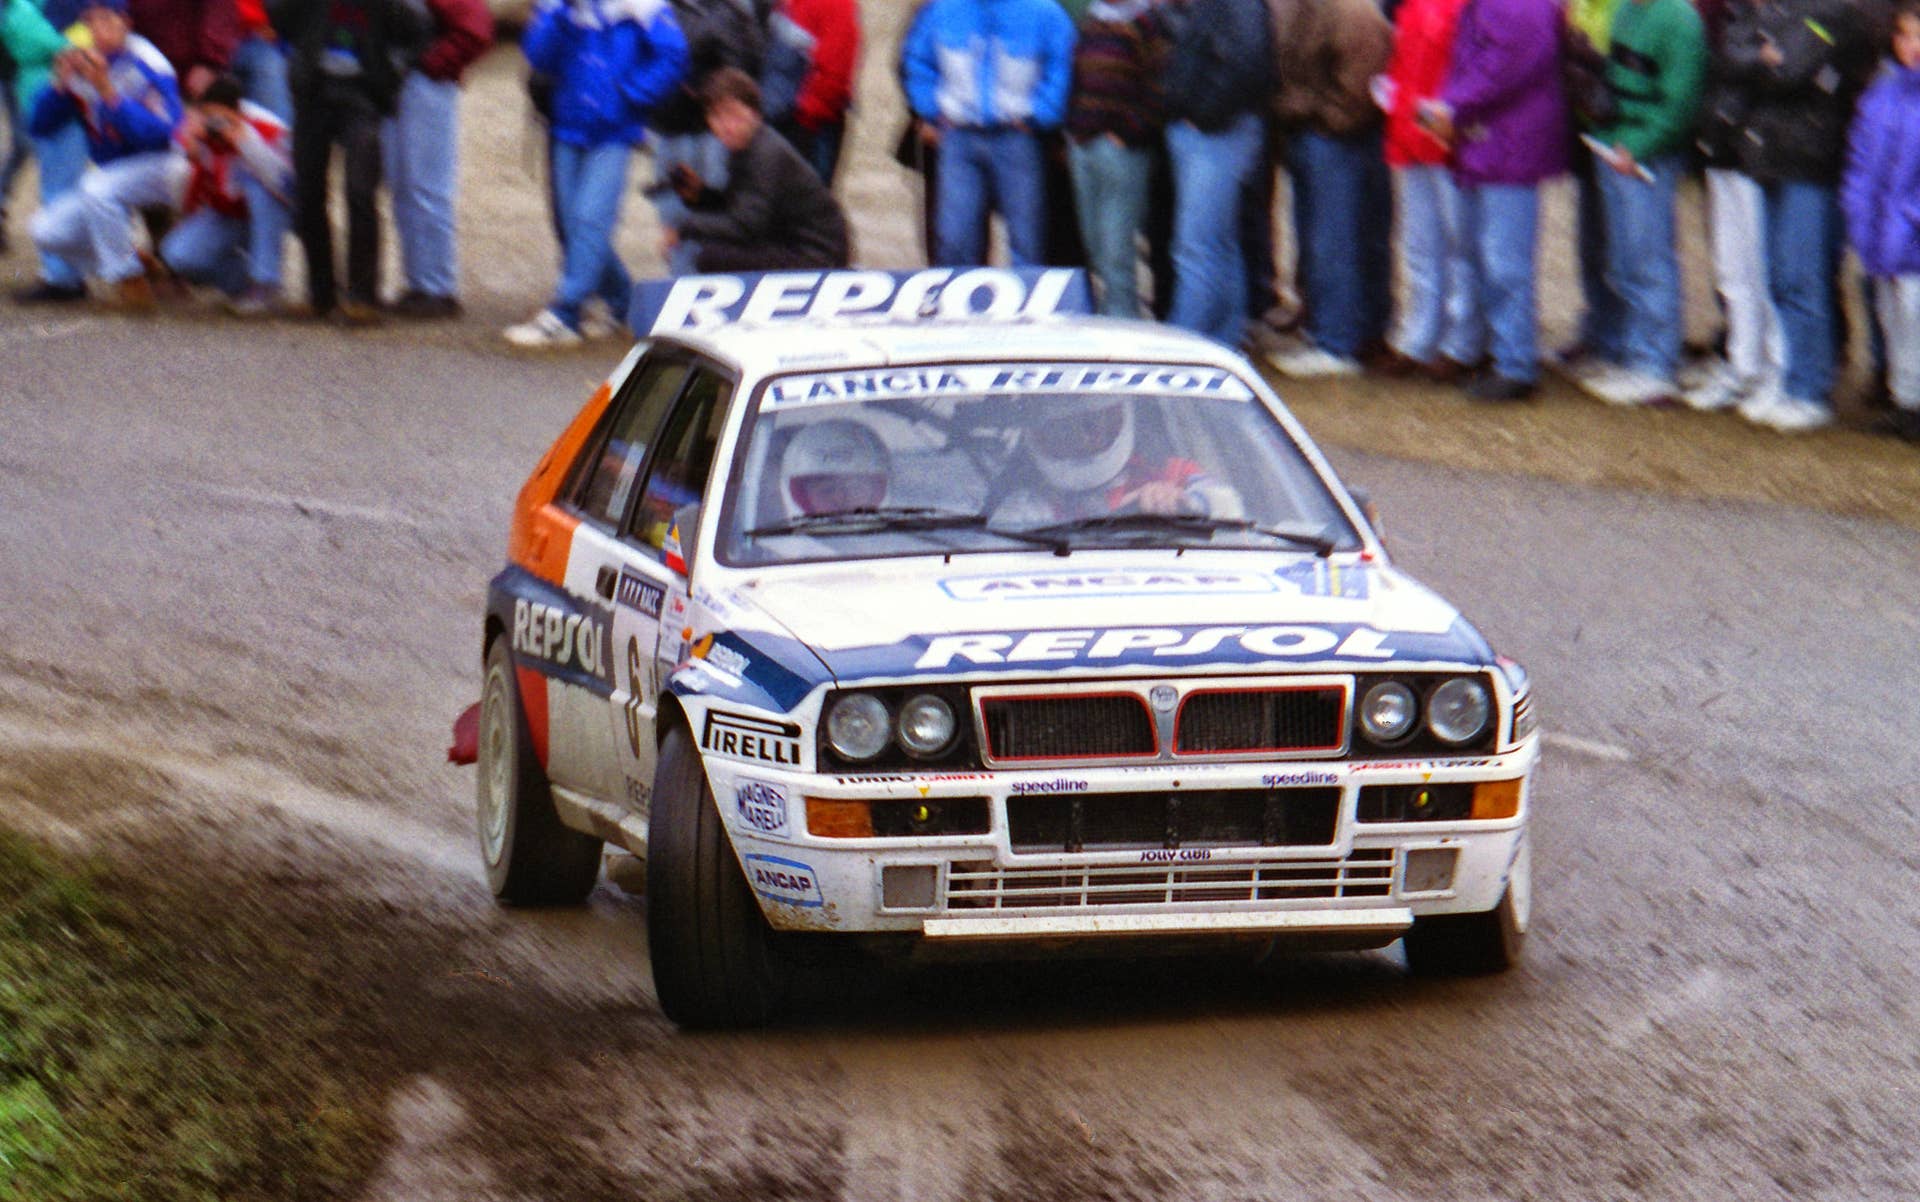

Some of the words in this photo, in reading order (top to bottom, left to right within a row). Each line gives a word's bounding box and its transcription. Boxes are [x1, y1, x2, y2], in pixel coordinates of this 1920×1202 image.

[772, 368, 967, 402] LANCIA
[513, 598, 606, 678] REPSOL
[914, 625, 1399, 668] REPSOL
[702, 708, 802, 765] PIRELLI
[1011, 778, 1088, 795] speedline
[1261, 771, 1338, 789] speedline
[756, 868, 812, 892] ANCAP
